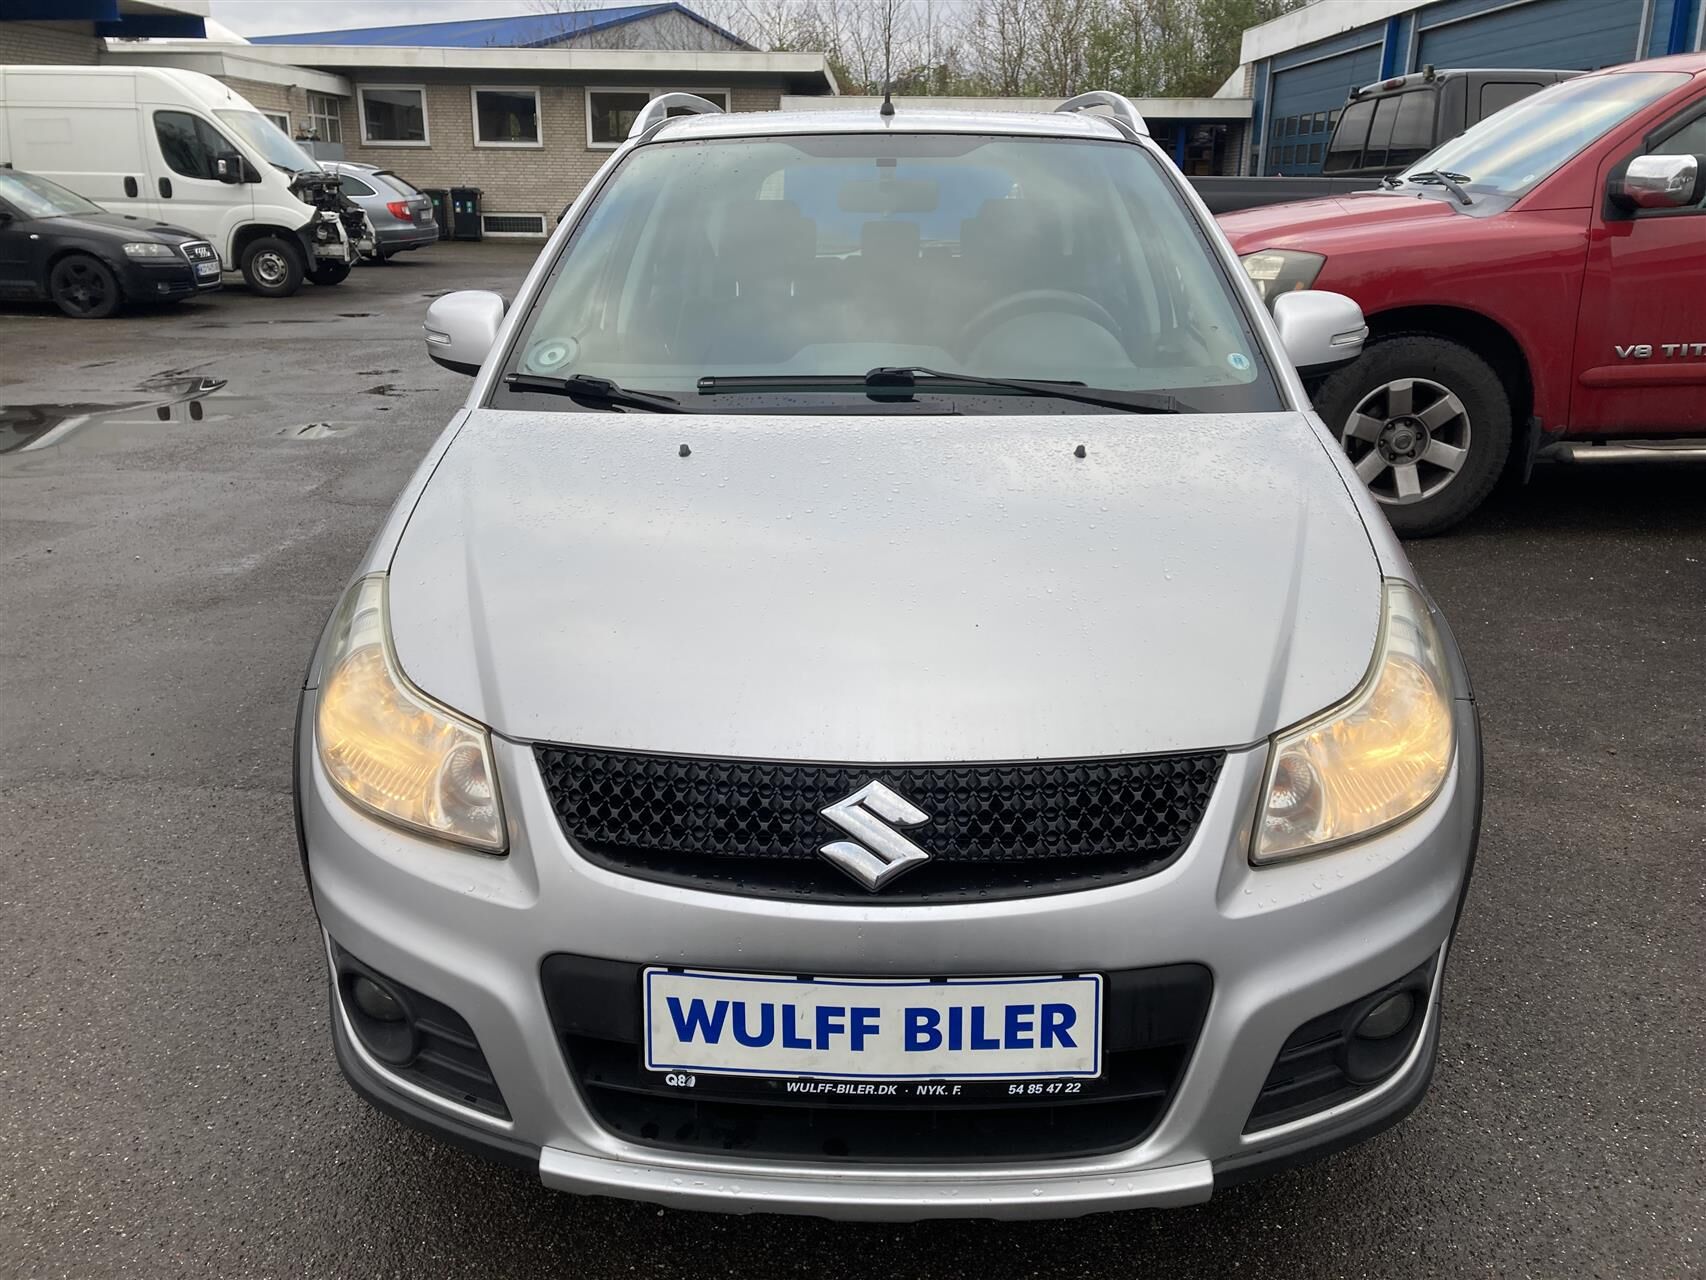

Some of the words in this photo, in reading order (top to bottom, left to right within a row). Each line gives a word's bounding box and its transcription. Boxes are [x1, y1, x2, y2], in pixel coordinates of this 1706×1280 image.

[1614, 344, 1653, 358] V8
[1661, 343, 1706, 357] TIT
[666, 996, 880, 1051] WULFF
[904, 1003, 1078, 1052] BILER
[665, 1073, 687, 1087] Q8
[786, 1081, 898, 1096] WULFF-BILER.DK
[916, 1084, 948, 1096] NYK.
[952, 1085, 962, 1096] F.
[1008, 1084, 1024, 1095] 54
[1027, 1083, 1043, 1094] 85
[1046, 1083, 1063, 1094] 47
[1065, 1082, 1082, 1093] 22
